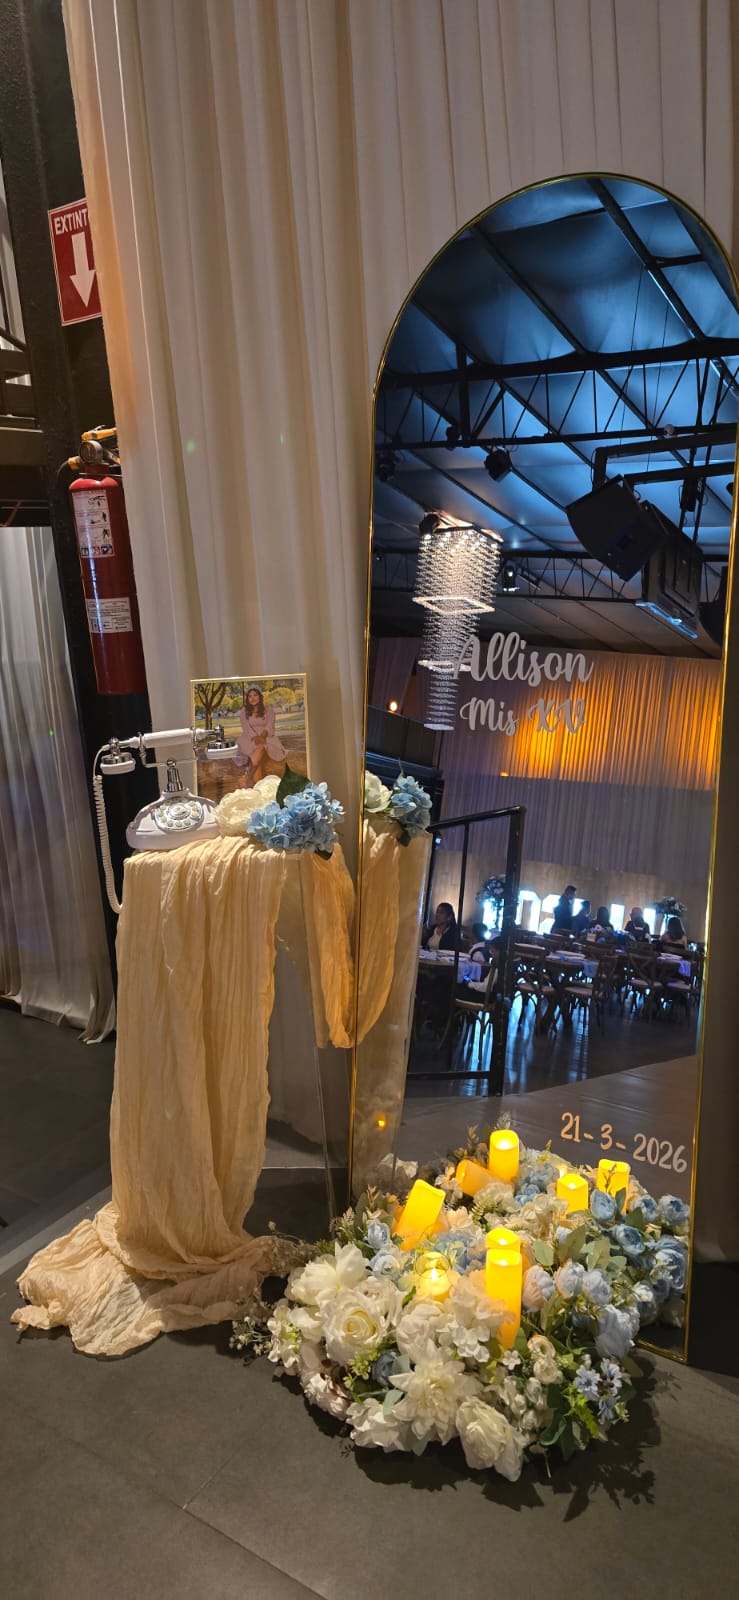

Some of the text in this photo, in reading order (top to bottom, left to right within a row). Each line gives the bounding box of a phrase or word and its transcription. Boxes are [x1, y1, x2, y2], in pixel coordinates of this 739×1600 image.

[452, 631, 595, 688] Allison
[459, 696, 587, 737] Mis XV
